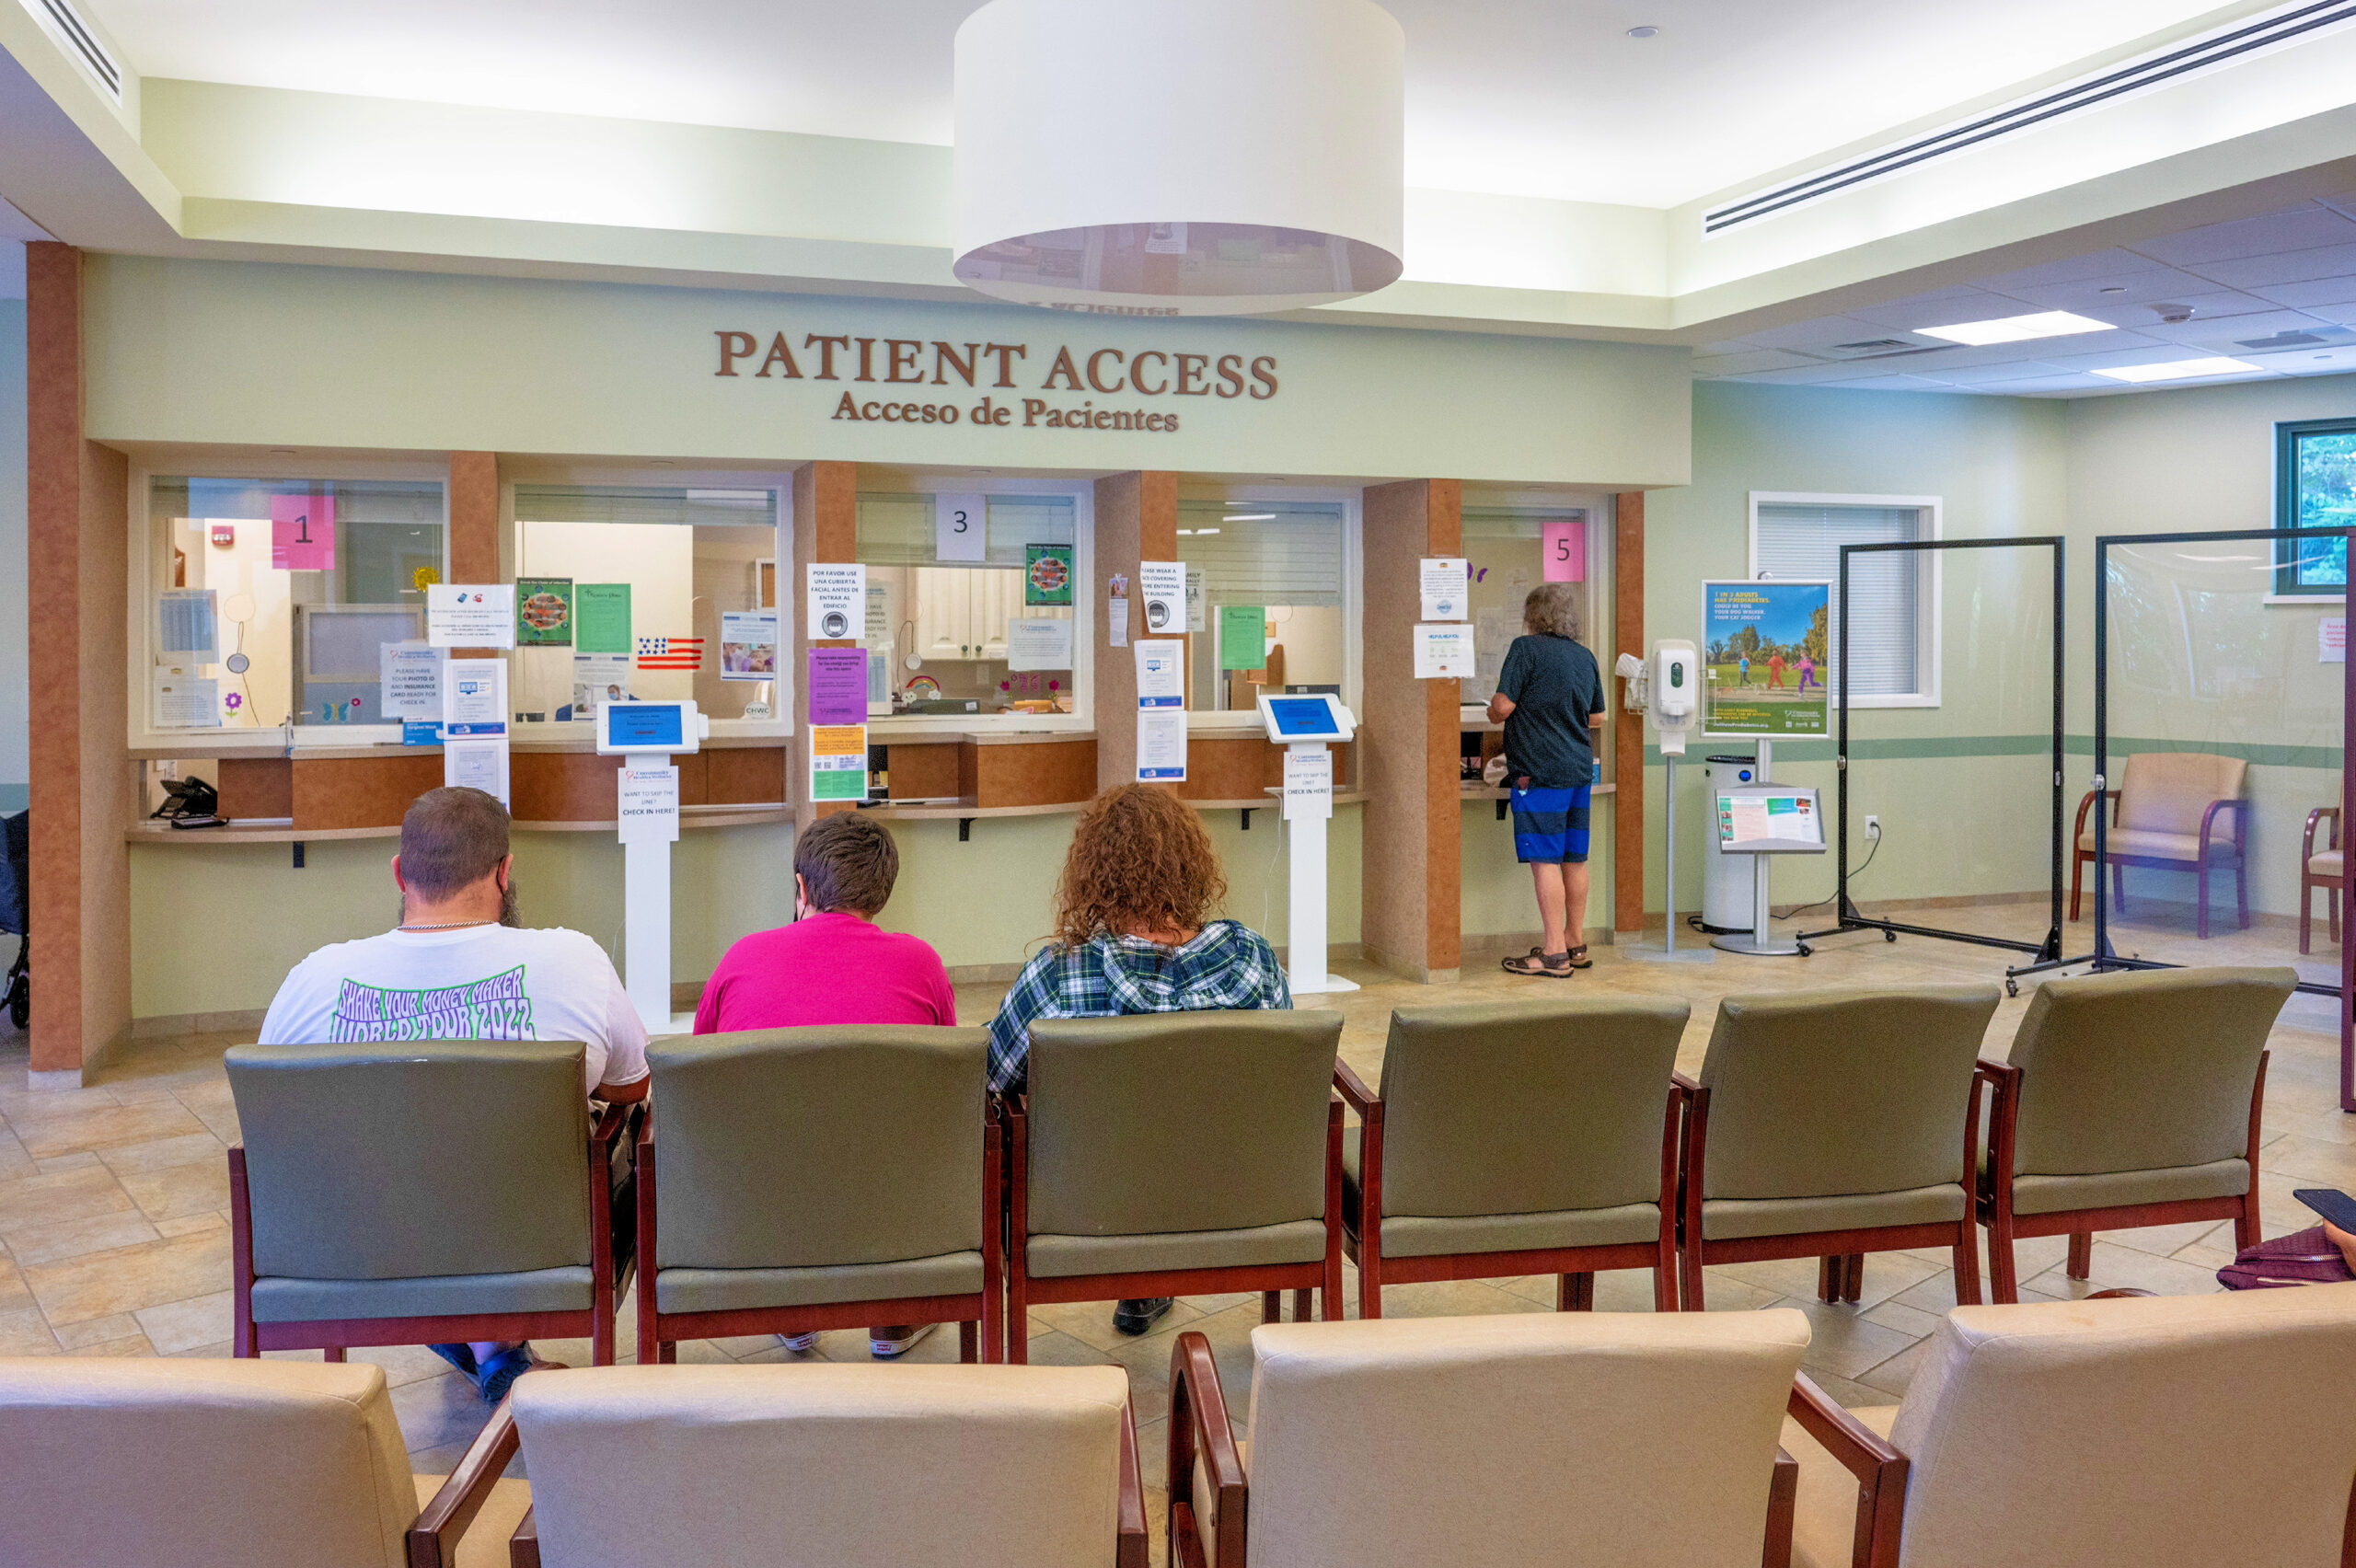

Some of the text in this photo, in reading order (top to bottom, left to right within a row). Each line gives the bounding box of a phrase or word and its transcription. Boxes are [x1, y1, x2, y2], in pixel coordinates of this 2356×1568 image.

[714, 330, 1278, 400] PATIENT ACCESS
[832, 391, 1180, 432] Acceso de Pacientes
[294, 514, 313, 544] 1
[953, 511, 968, 533] 3
[1557, 538, 1570, 561] 5
[338, 965, 525, 1021] SHAKE YOUR MONEY MAKER
[330, 997, 537, 1043] WORLD TOUR 2022
